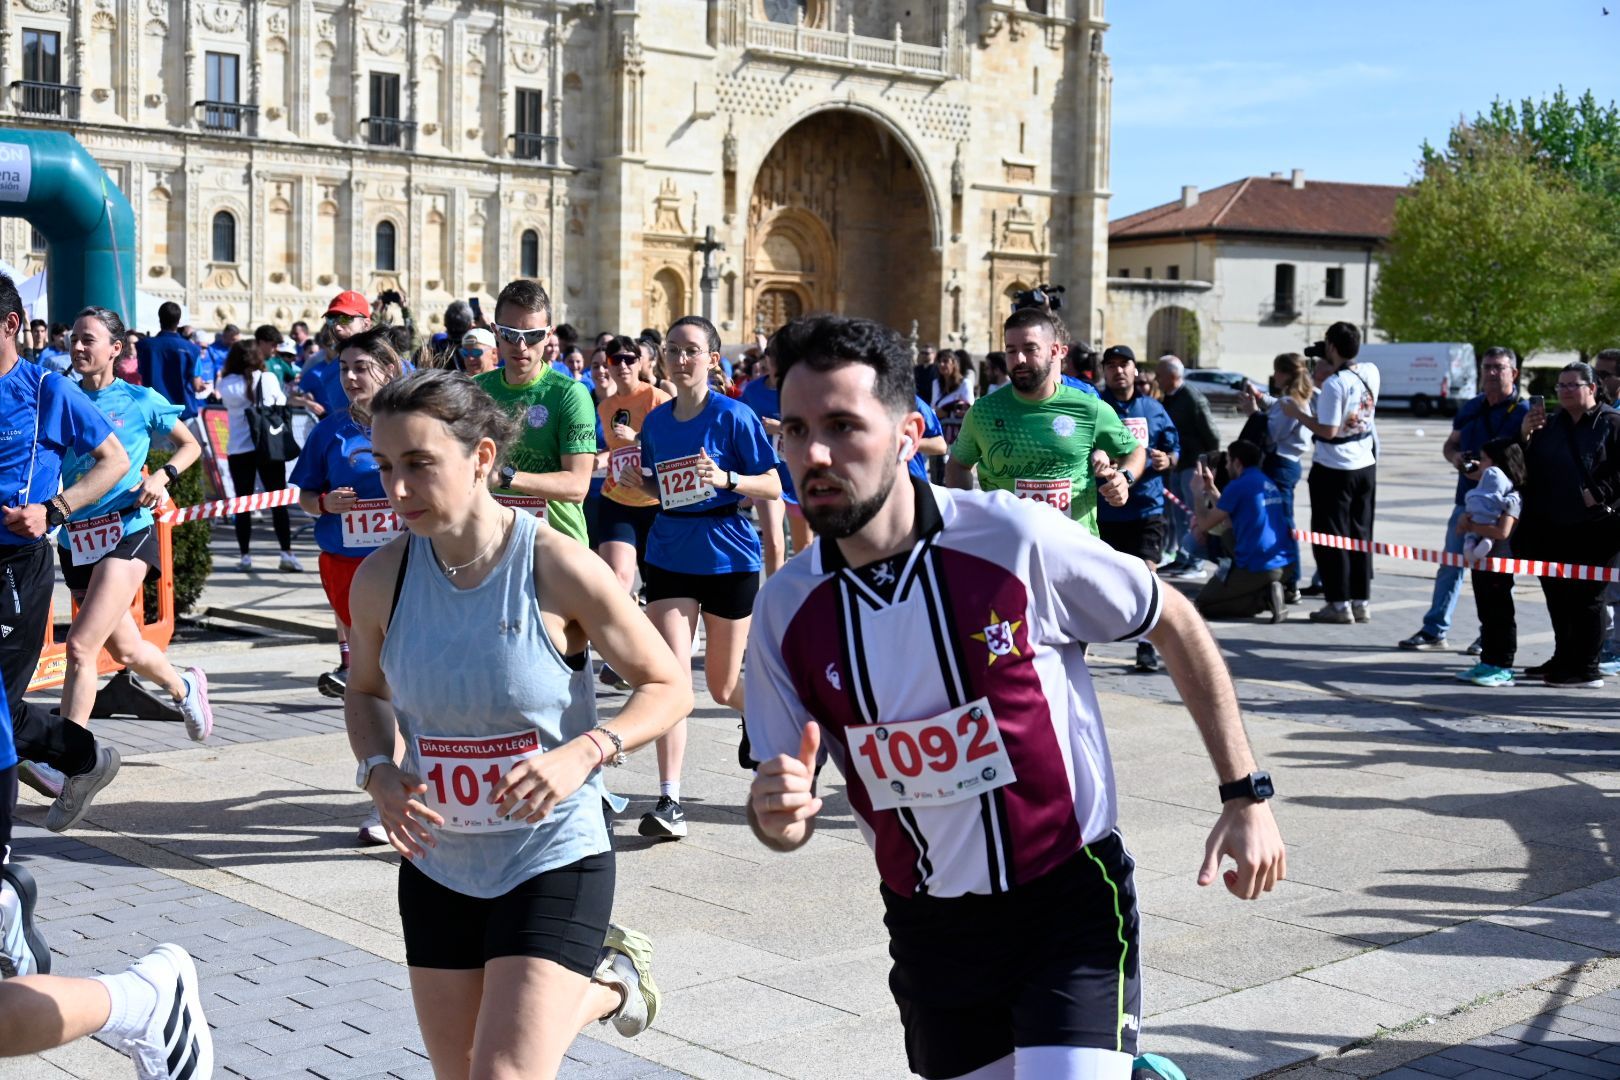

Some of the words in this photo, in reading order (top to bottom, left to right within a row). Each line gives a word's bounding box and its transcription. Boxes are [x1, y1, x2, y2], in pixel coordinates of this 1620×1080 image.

[0, 170, 20, 182] na
[345, 511, 398, 534] 1121
[72, 525, 122, 553] 1173
[422, 741, 438, 752] DÍA
[438, 744, 452, 753] DE
[452, 744, 496, 754] CASTILLA
[496, 743, 504, 752] Y
[505, 735, 534, 751] LEÓN
[858, 710, 1000, 780] 1092
